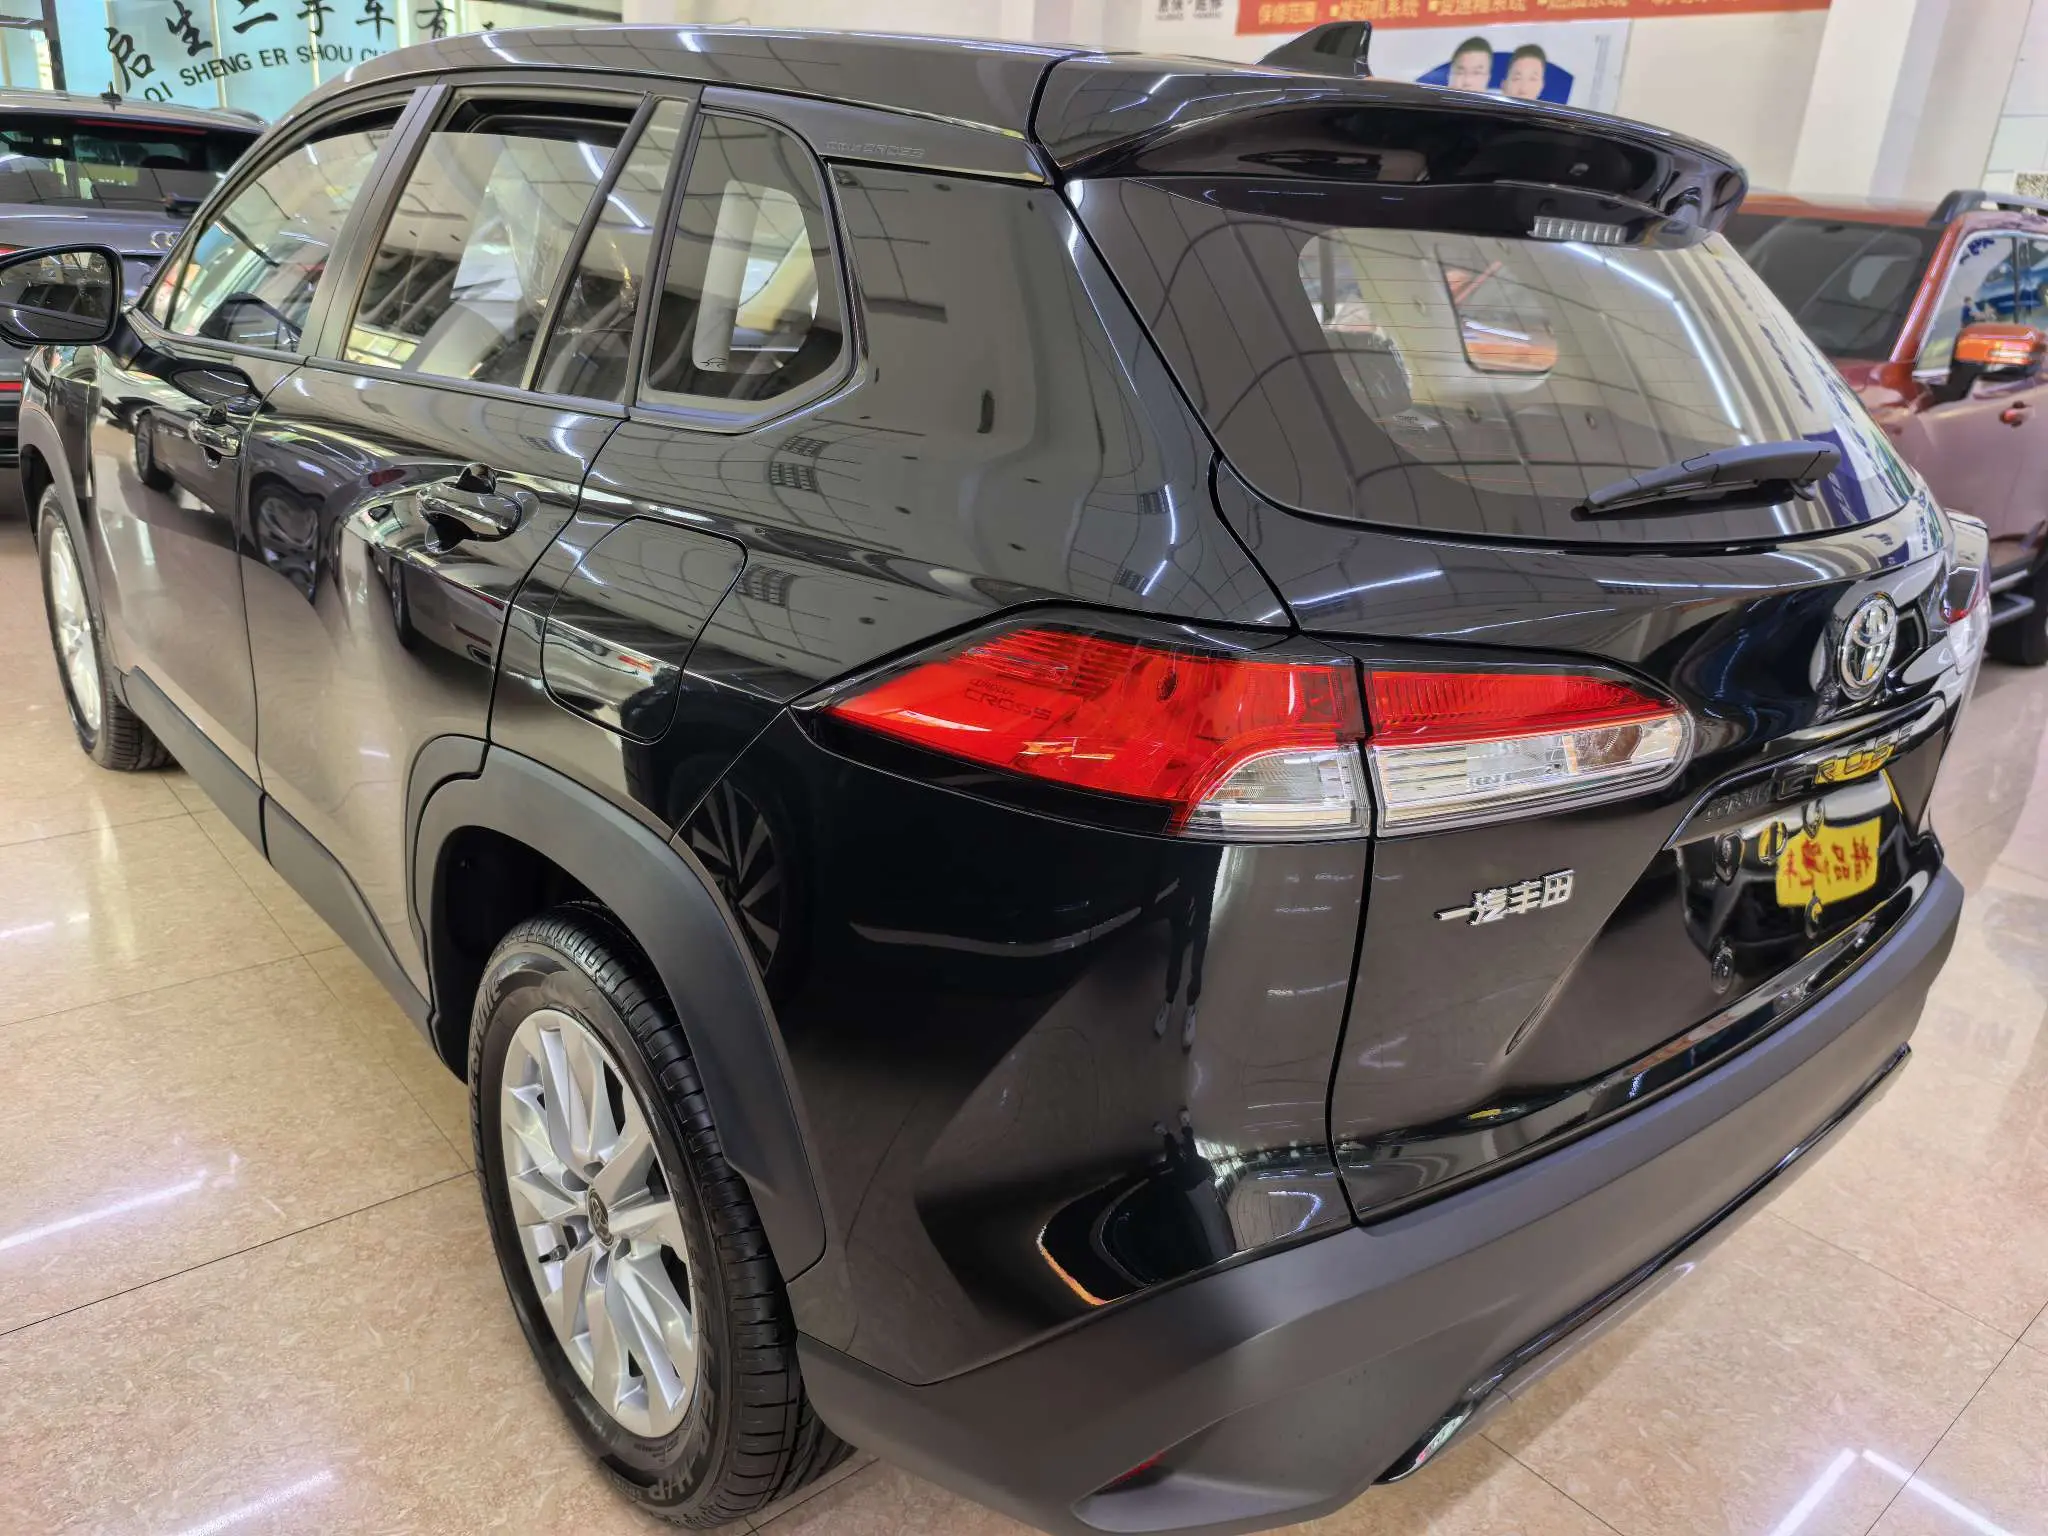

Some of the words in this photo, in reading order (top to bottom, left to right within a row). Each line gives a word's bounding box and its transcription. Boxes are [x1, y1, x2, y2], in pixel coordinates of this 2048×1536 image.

[144, 81, 174, 102] QI
[179, 53, 253, 86] SHENG
[259, 48, 289, 67] ER
[296, 44, 353, 63] SHOU
[1436, 868, 1576, 926] 一汽丰田
